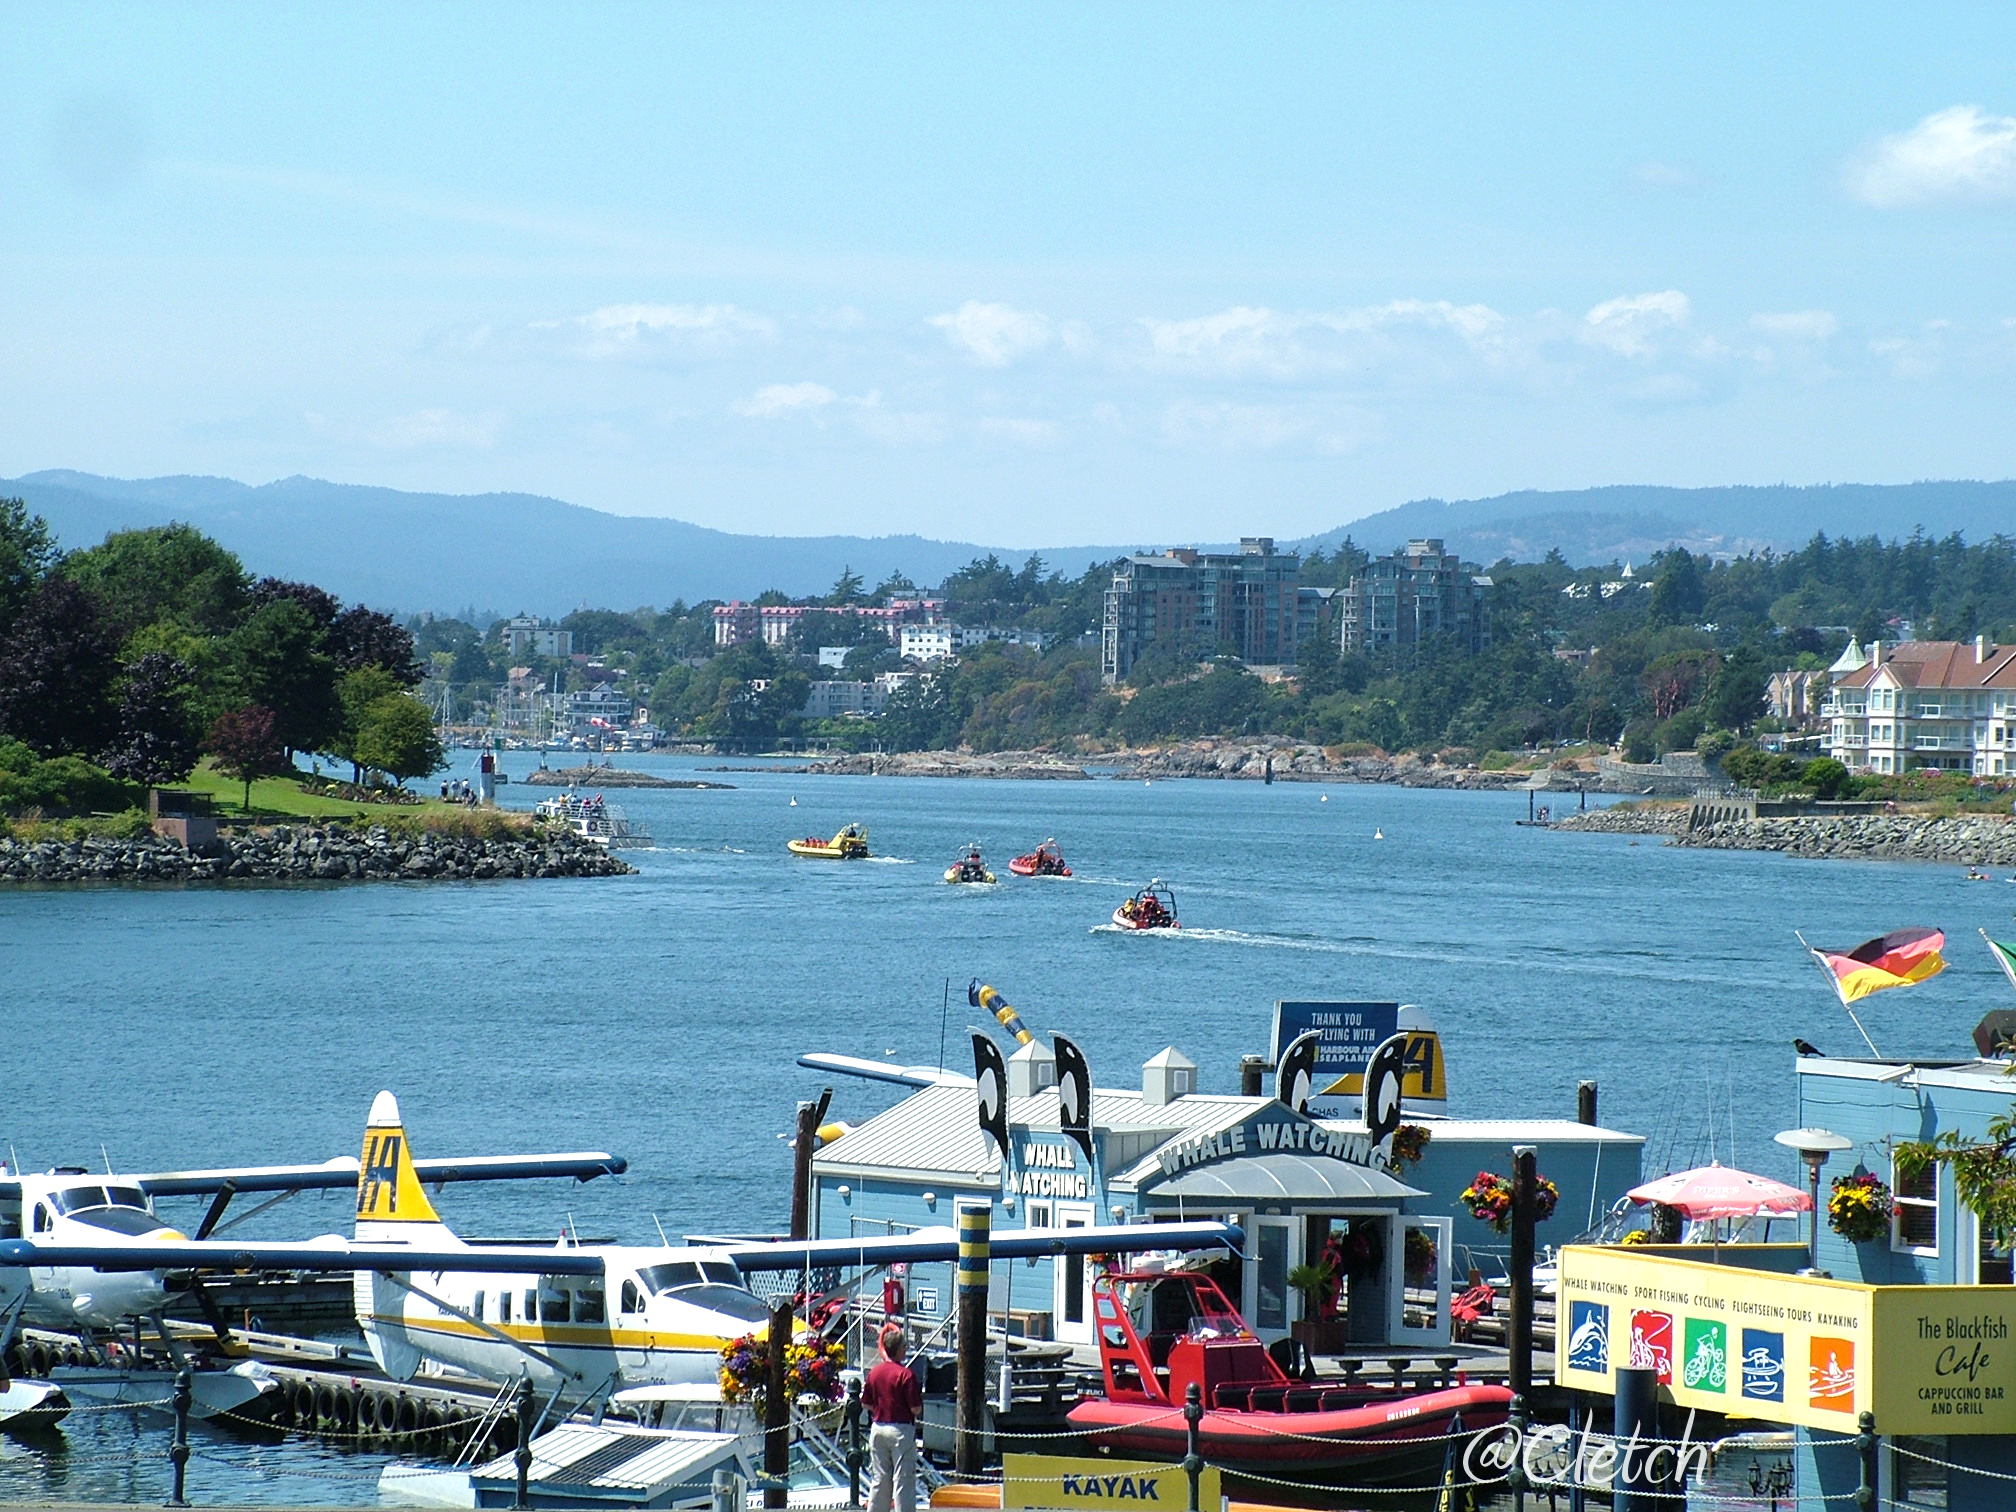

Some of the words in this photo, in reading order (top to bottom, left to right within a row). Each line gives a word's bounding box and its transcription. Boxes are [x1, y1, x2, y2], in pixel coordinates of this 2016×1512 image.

[1312, 1013, 1341, 1026] THANK
[1344, 1013, 1362, 1026] YOU
[1319, 1028, 1350, 1041] FLYING
[1353, 1029, 1376, 1041] WITH
[1320, 1046, 1360, 1054] HARBOUR
[1157, 1125, 1246, 1176] WHALE
[1257, 1123, 1386, 1172] WATCHING
[1009, 1171, 1087, 1198] WATCHING
[1564, 1277, 1588, 1290] WHALE
[1591, 1280, 1628, 1296] WATCHING
[1634, 1286, 1657, 1300] SPORT
[1660, 1290, 1689, 1305] FISHING
[1694, 1294, 1725, 1310] CYCLING
[1732, 1300, 1785, 1319] FLIGHTSEEING
[1787, 1308, 1812, 1323] TOURS
[1818, 1313, 1858, 1329] KAYAKING
[1917, 1316, 1941, 1339] The
[1946, 1315, 2007, 1339] Blackfish
[1935, 1341, 1990, 1382] Cafe
[1918, 1387, 1981, 1400] CAPPUCCINO
[1985, 1387, 2004, 1400] BAR
[1931, 1402, 1953, 1414] AND
[1956, 1402, 1984, 1414] GRILL
[1063, 1474, 1159, 1501] KAYAK
